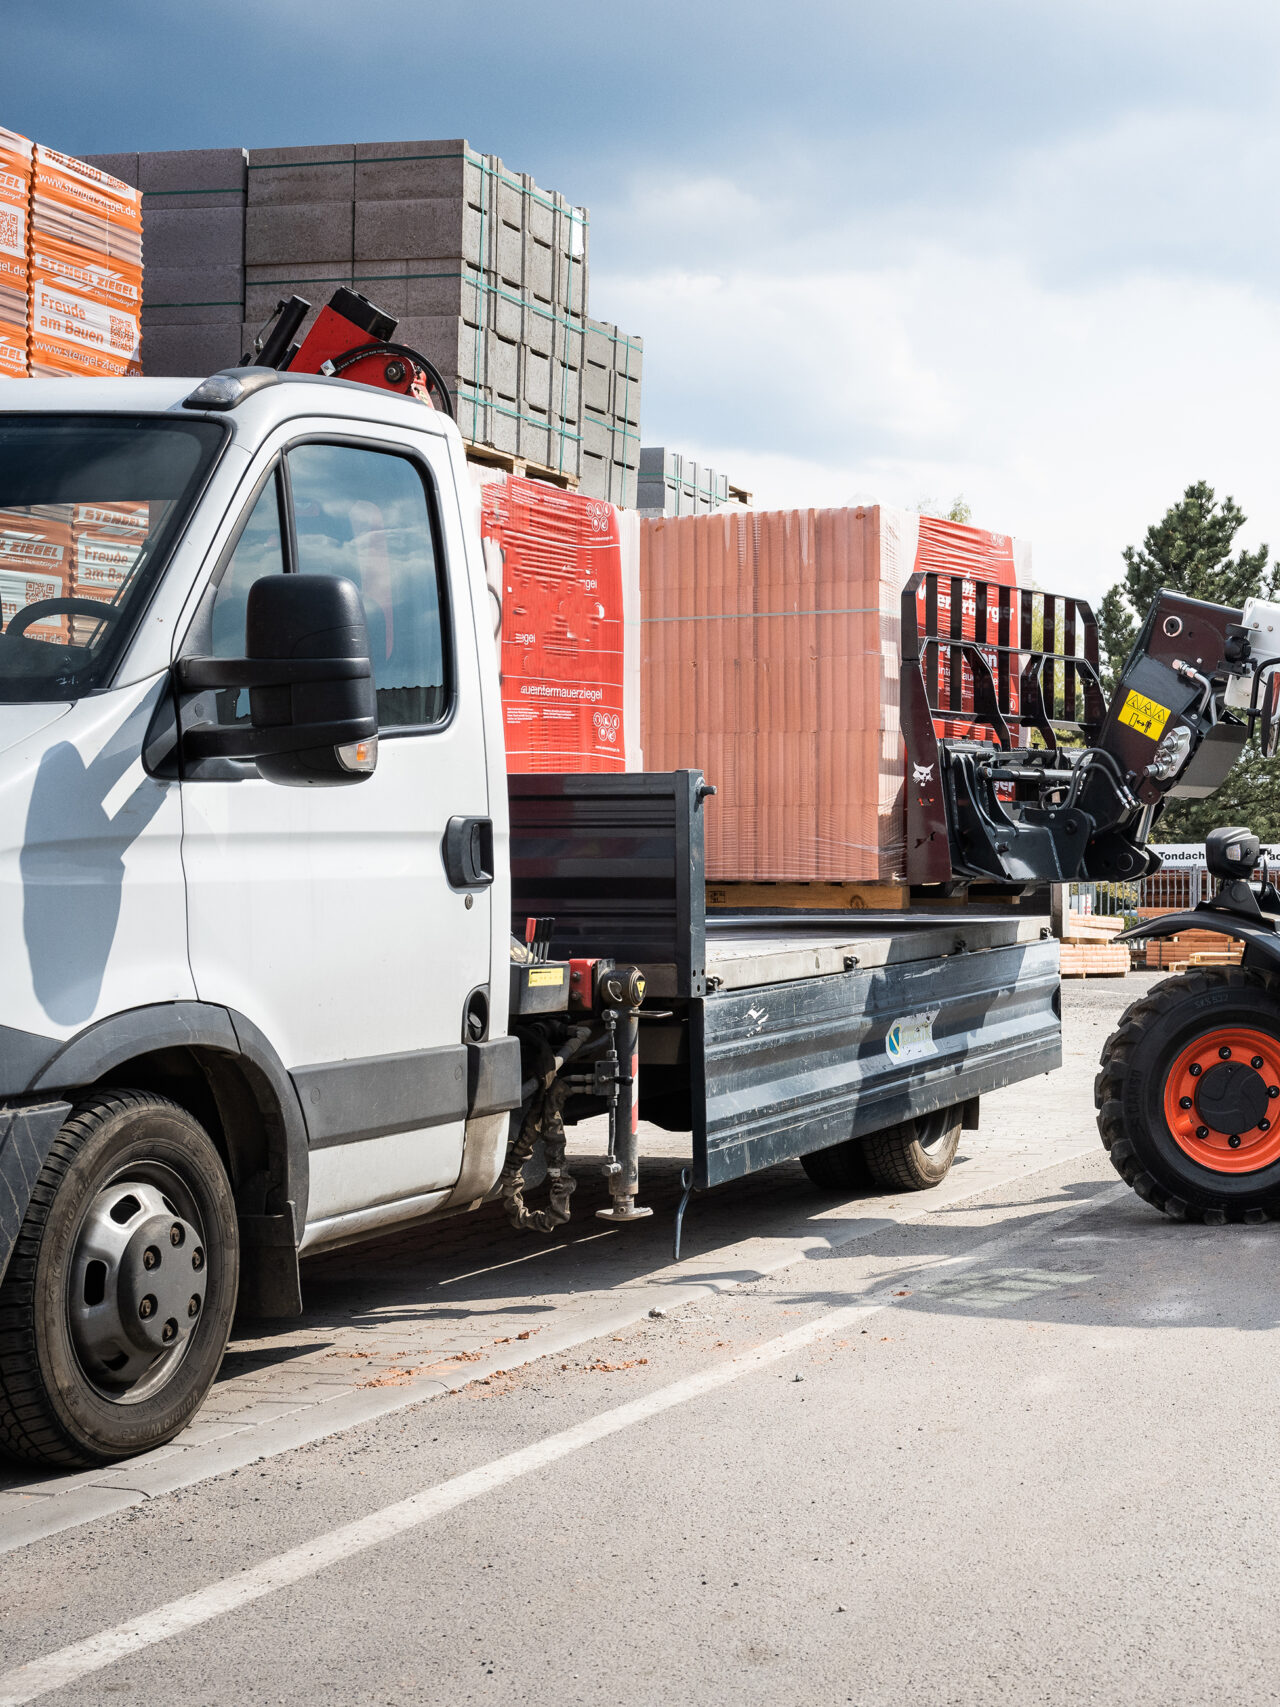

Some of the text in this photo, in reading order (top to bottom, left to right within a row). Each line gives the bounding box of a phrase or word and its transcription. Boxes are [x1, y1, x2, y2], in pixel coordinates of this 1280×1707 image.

[97, 277, 134, 297] ZIEGEL
[41, 292, 86, 320] Freude
[39, 315, 104, 345] am Bauen
[35, 340, 140, 377] www.stengel-ziegel.de
[84, 545, 128, 566] Freude
[84, 567, 104, 582] am
[1158, 851, 1205, 860] Tondach
